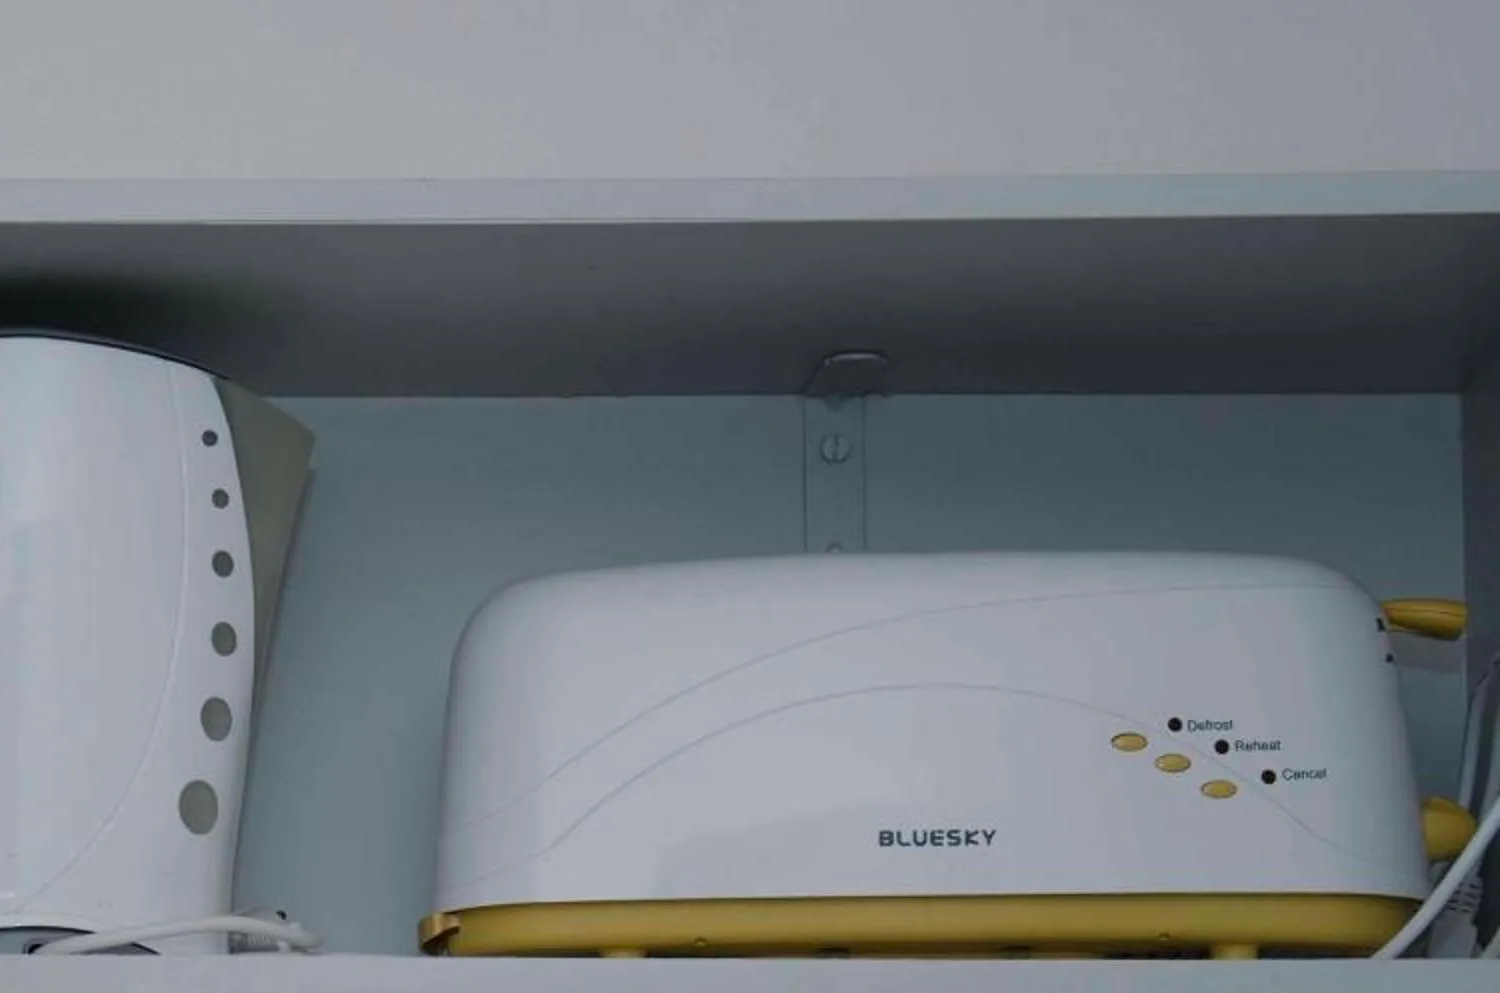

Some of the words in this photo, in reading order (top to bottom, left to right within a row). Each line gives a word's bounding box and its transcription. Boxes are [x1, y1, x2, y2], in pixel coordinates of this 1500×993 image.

[1187, 719, 1233, 732] Defrost
[1235, 739, 1281, 752] Reheat
[1281, 767, 1327, 781] Cancel
[878, 829, 997, 847] BLUESKY
